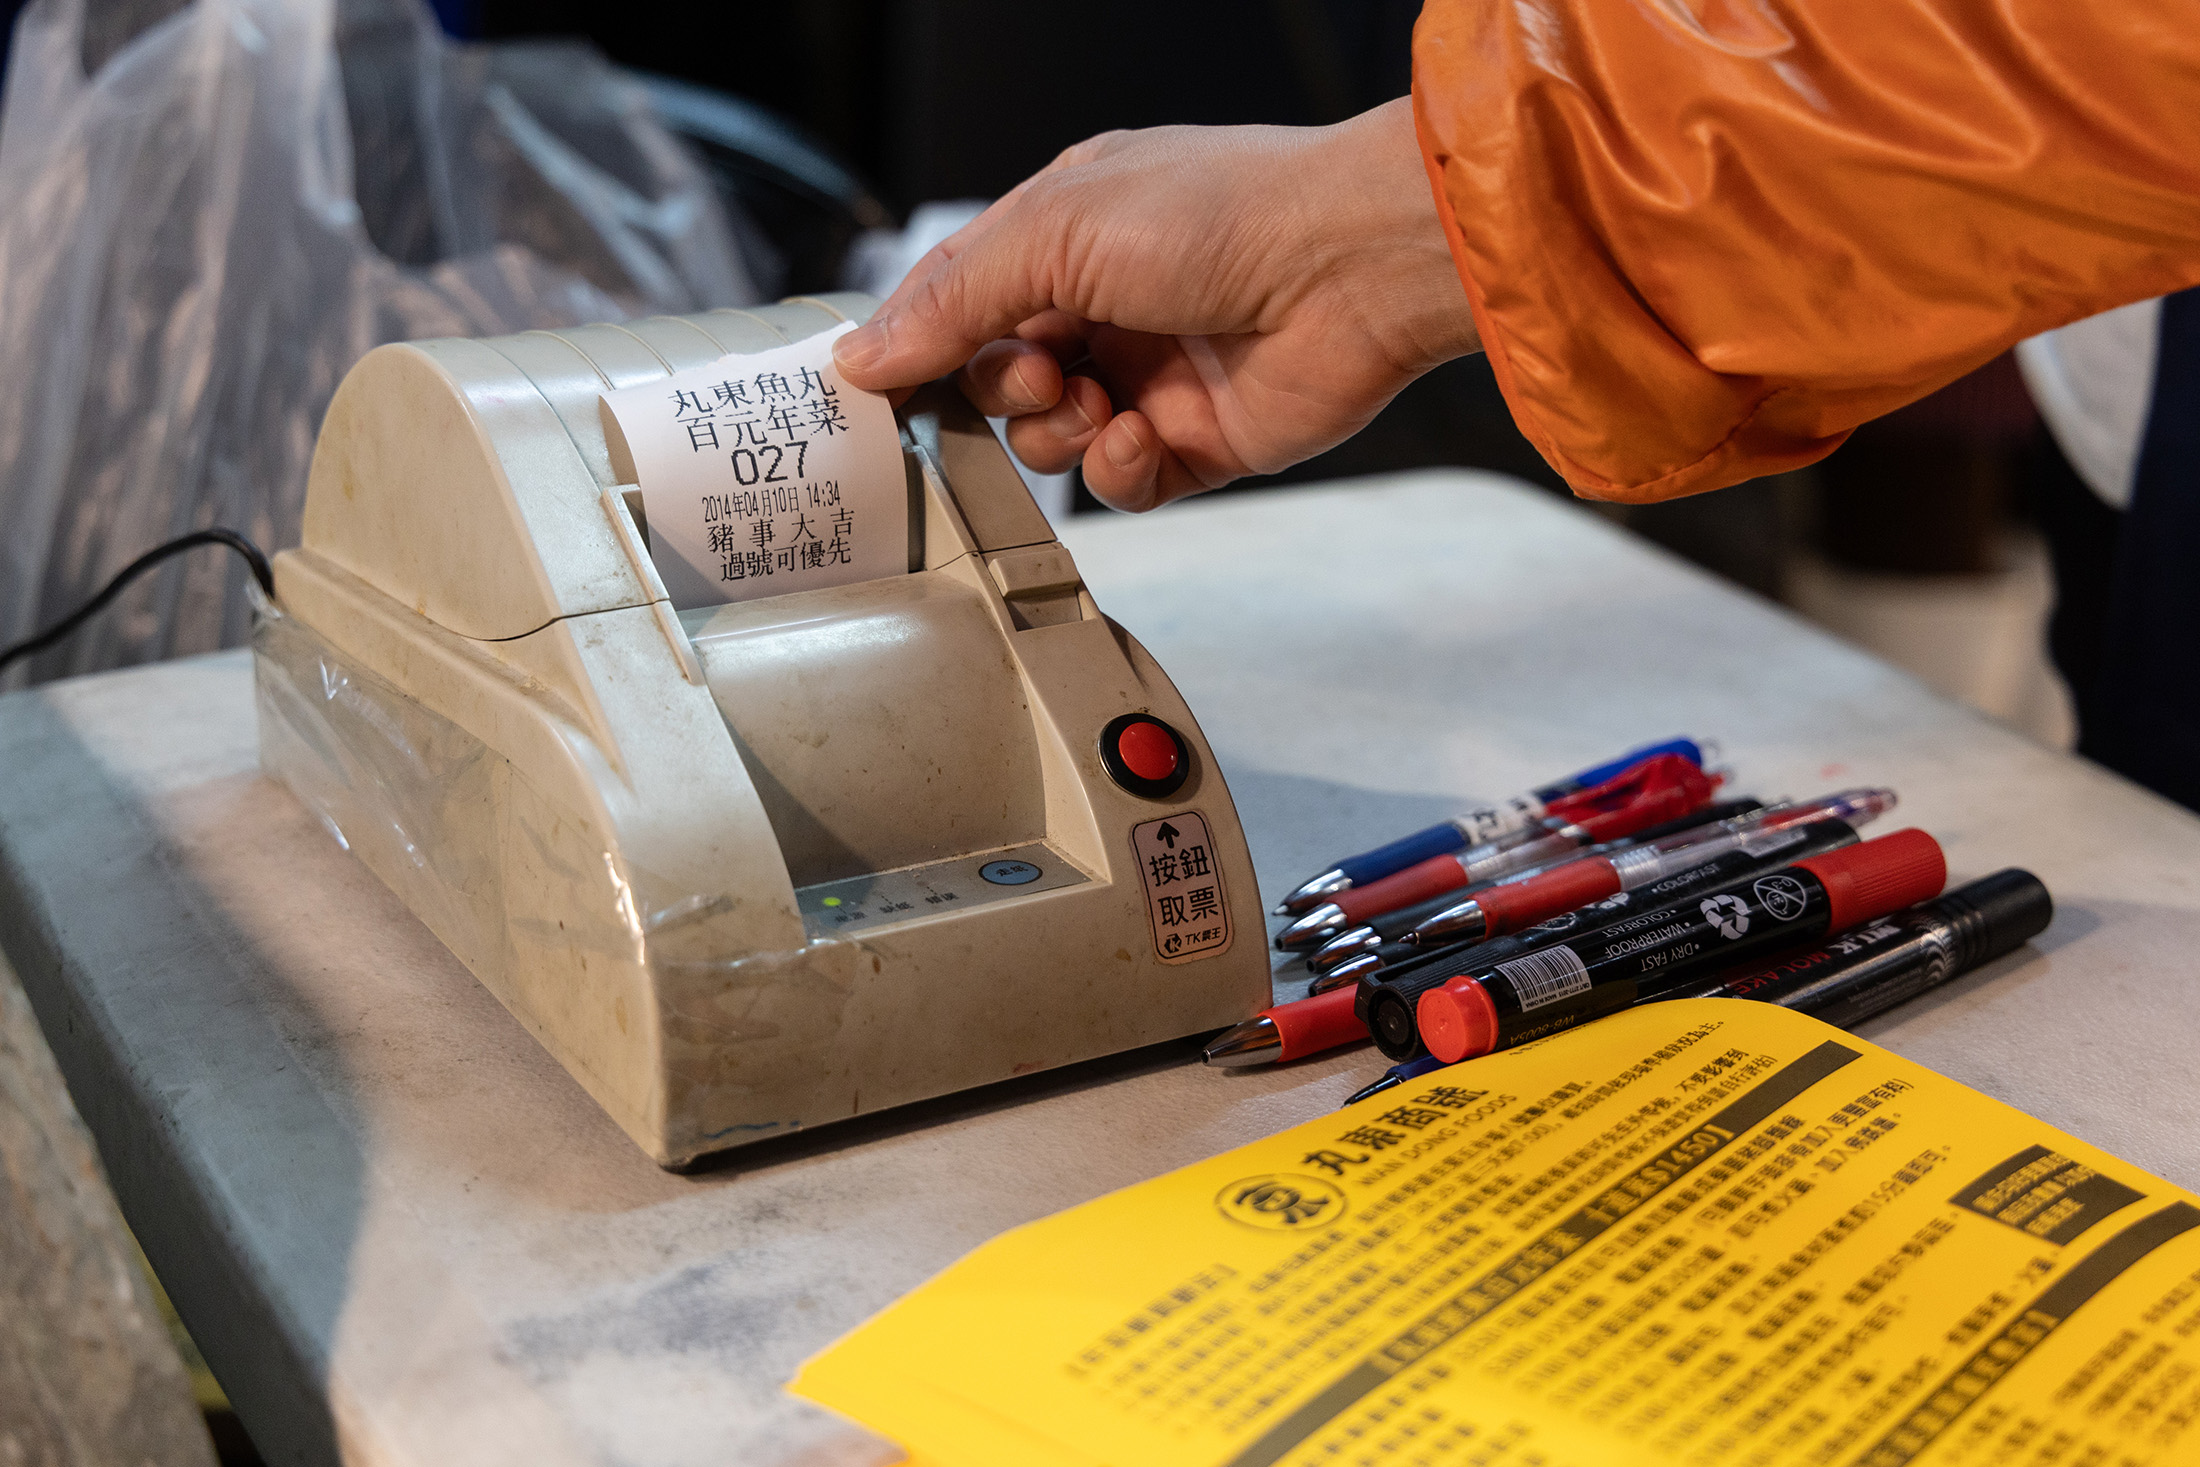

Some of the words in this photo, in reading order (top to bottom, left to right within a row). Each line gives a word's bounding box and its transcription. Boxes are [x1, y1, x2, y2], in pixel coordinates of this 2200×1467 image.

[668, 366, 836, 418] 丸東魚丸
[677, 398, 849, 452] 百元年菜
[731, 441, 808, 486] 027
[702, 486, 800, 523] 2014年04月10日
[806, 480, 841, 510] 14:34
[720, 537, 852, 582] 過號可優先
[1149, 845, 1211, 887] 按鈕
[1158, 886, 1218, 927] 取票
[1602, 910, 1672, 938] COLORFAST
[1605, 923, 1686, 960] WATERPROOF
[1669, 943, 1694, 963] DRY
[1641, 954, 1668, 973] FAST
[1402, 1125, 1456, 1160] DONG
[1454, 1093, 1517, 1128] FOODS
